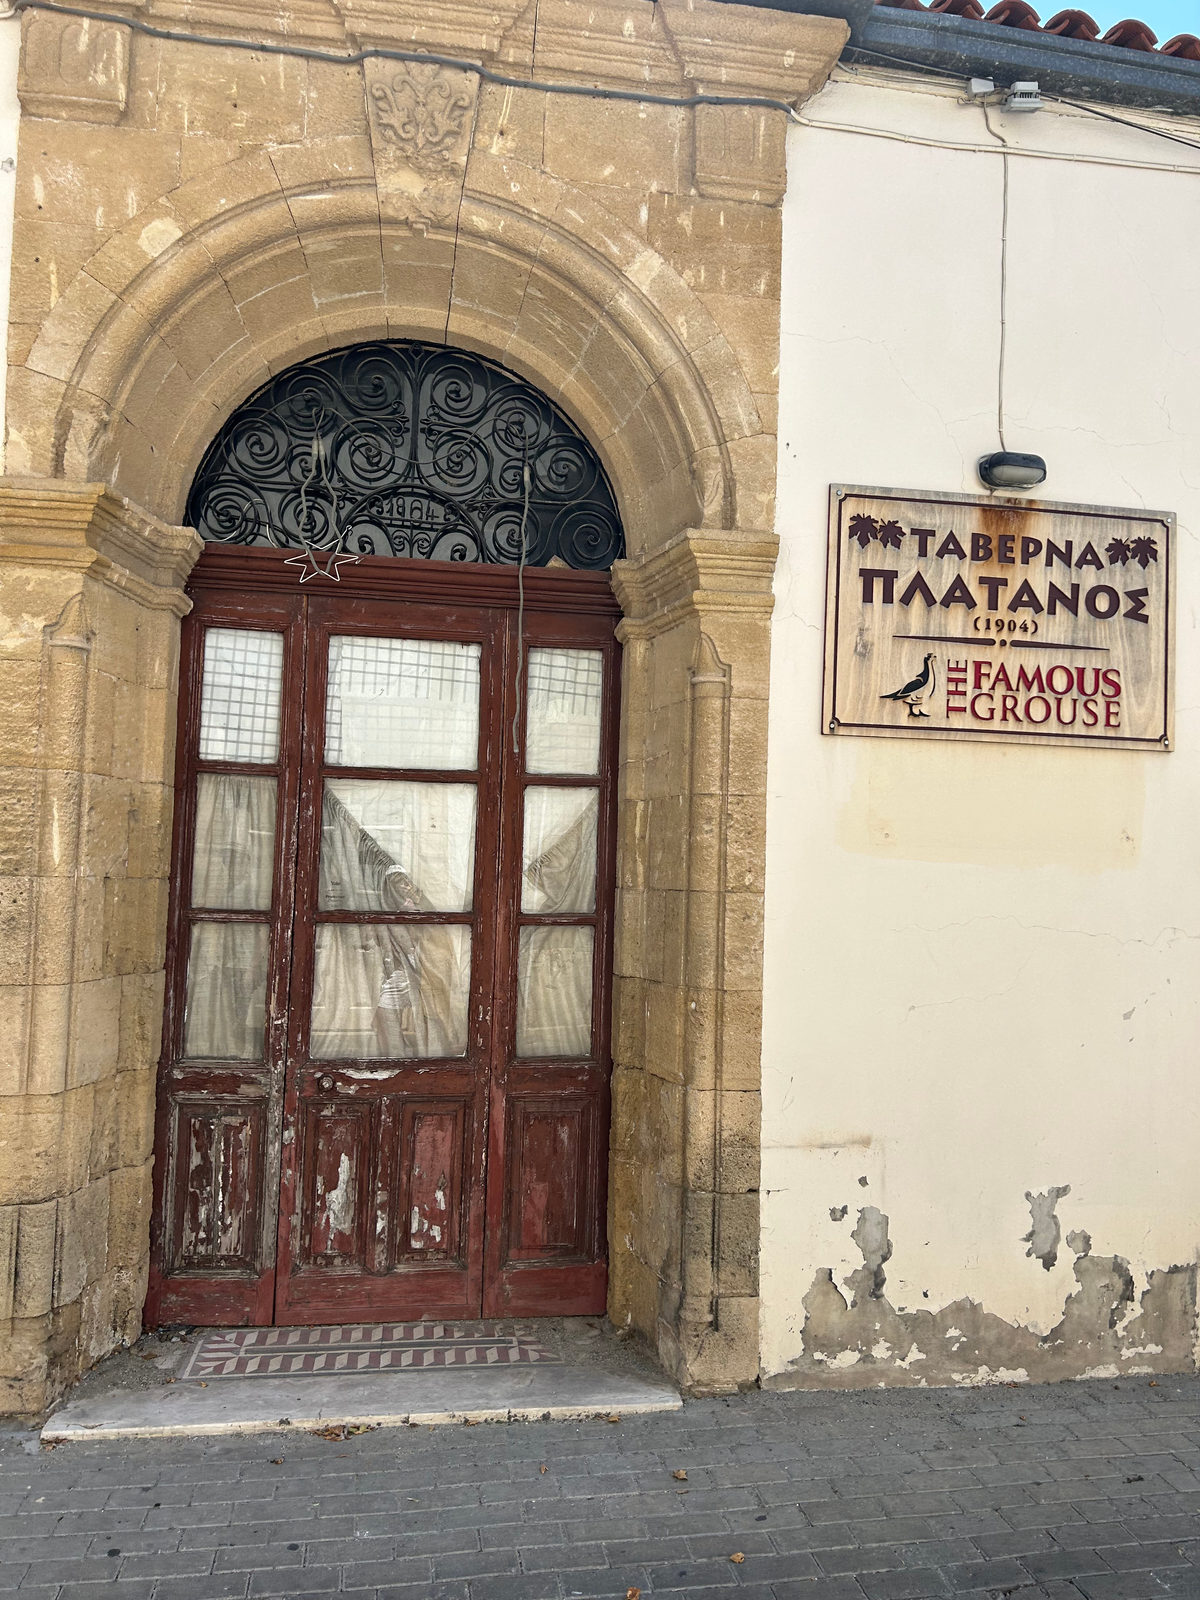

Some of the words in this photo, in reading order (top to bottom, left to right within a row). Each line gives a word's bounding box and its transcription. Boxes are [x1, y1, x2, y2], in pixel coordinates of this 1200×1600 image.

[911, 528, 1105, 571] ΤΑΒΕΡΝΑ
[859, 567, 1150, 624] ΠΛΑΤΑΝΟΣ
[973, 615, 1039, 635] (1904)
[946, 658, 968, 718] THE
[972, 660, 1121, 698] FAMOUS
[970, 692, 1121, 728] GROUSE
